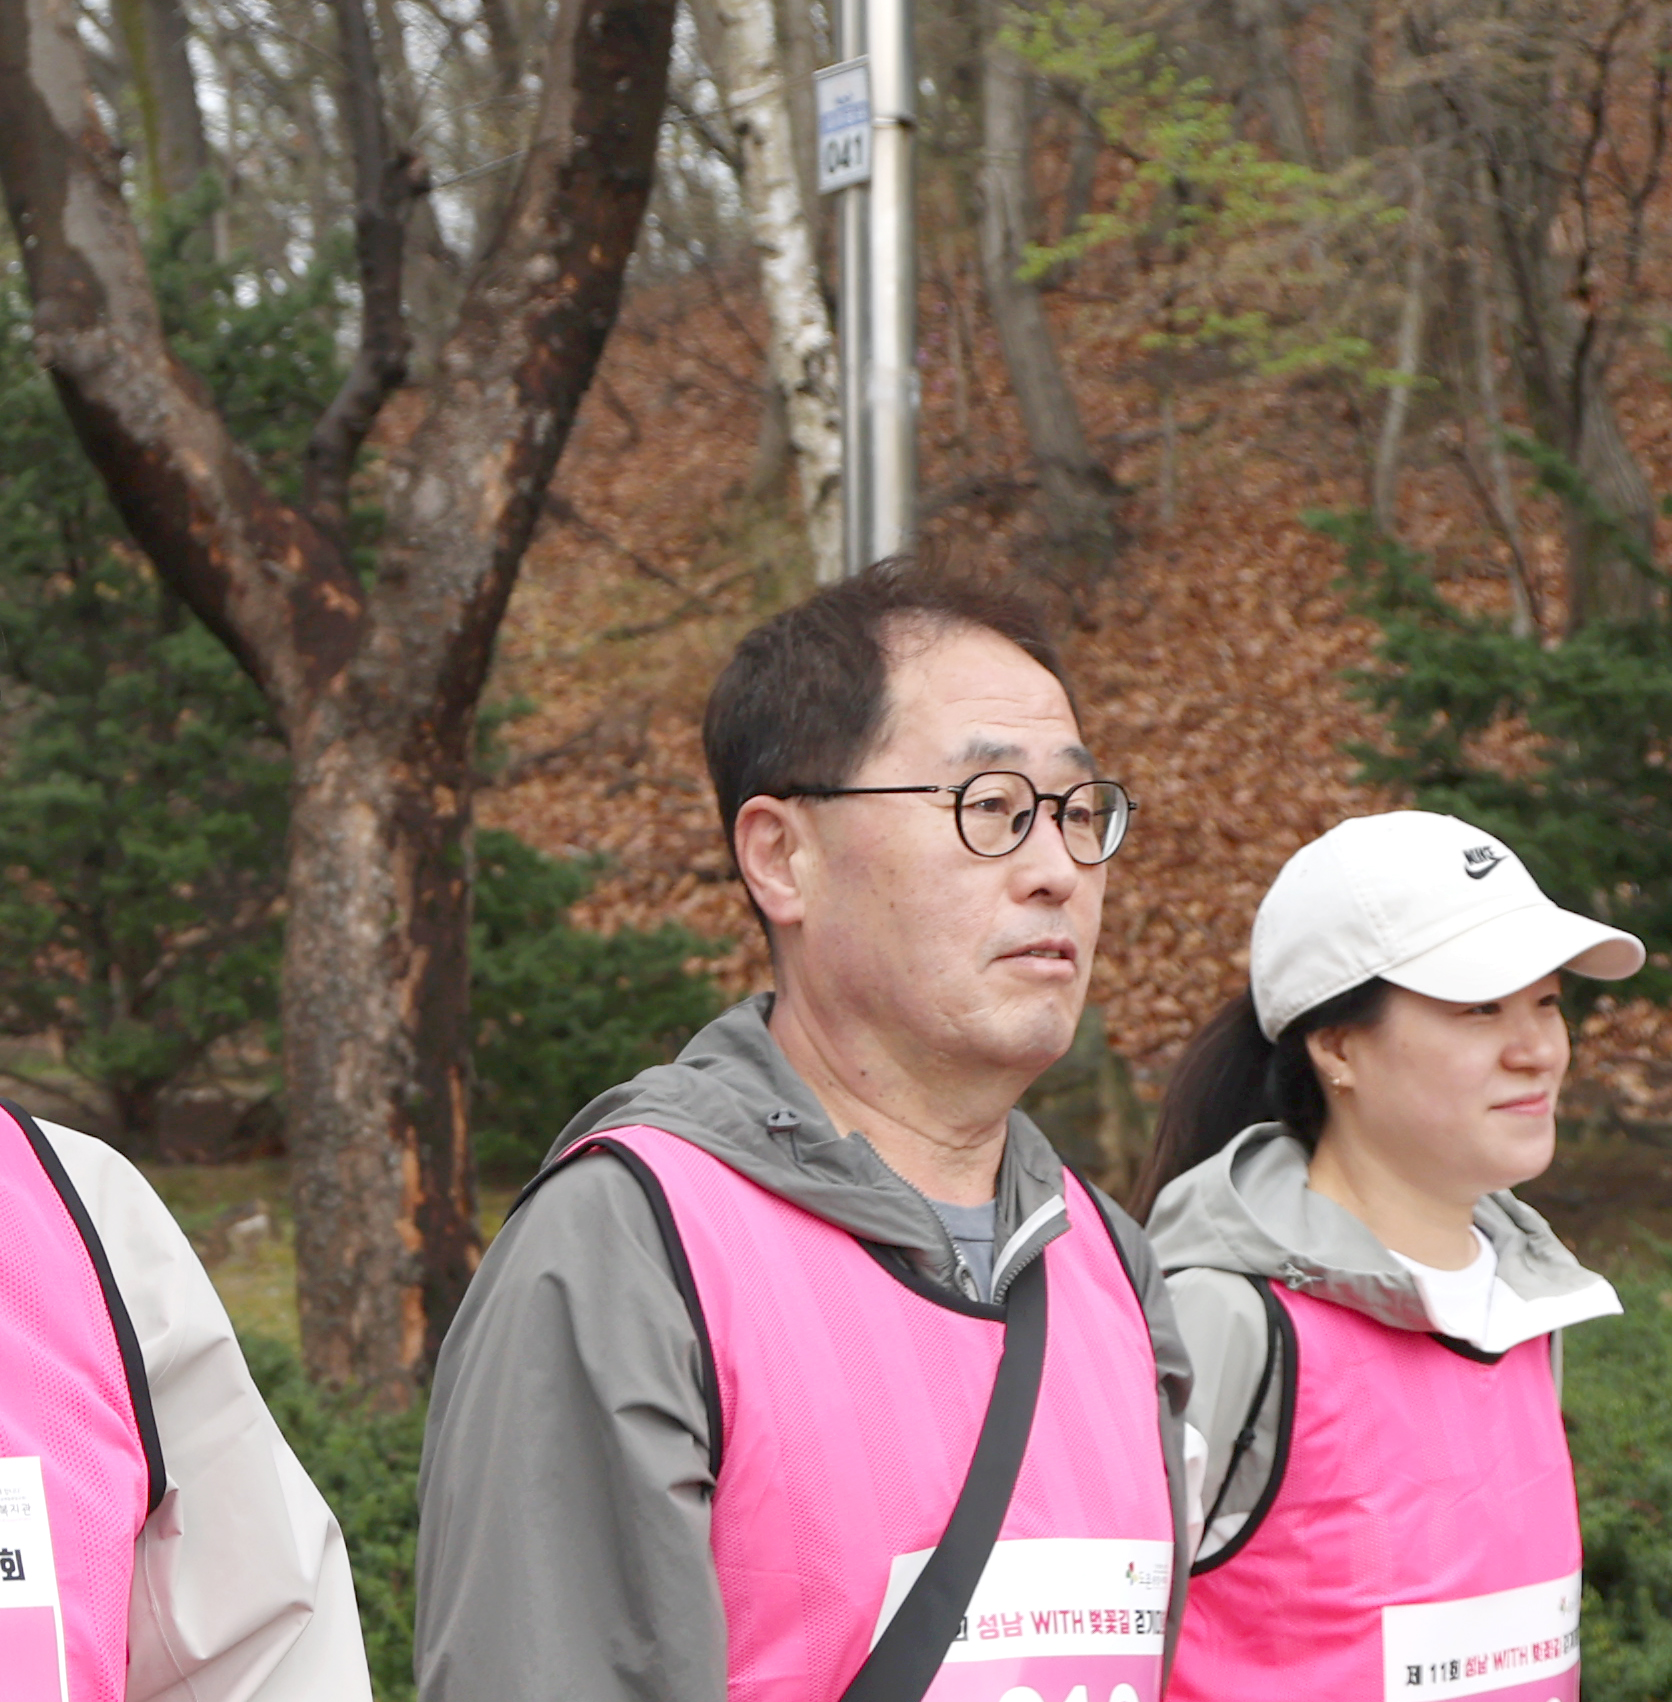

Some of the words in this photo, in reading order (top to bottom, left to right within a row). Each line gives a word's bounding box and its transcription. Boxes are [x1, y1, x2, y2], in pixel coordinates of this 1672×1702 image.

[977, 1612, 1023, 1640] 성남
[1030, 1610, 1084, 1635] WITH
[1089, 1609, 1131, 1635] 벚꽃길
[1466, 1654, 1488, 1677] 성남
[1493, 1643, 1528, 1672] WITH
